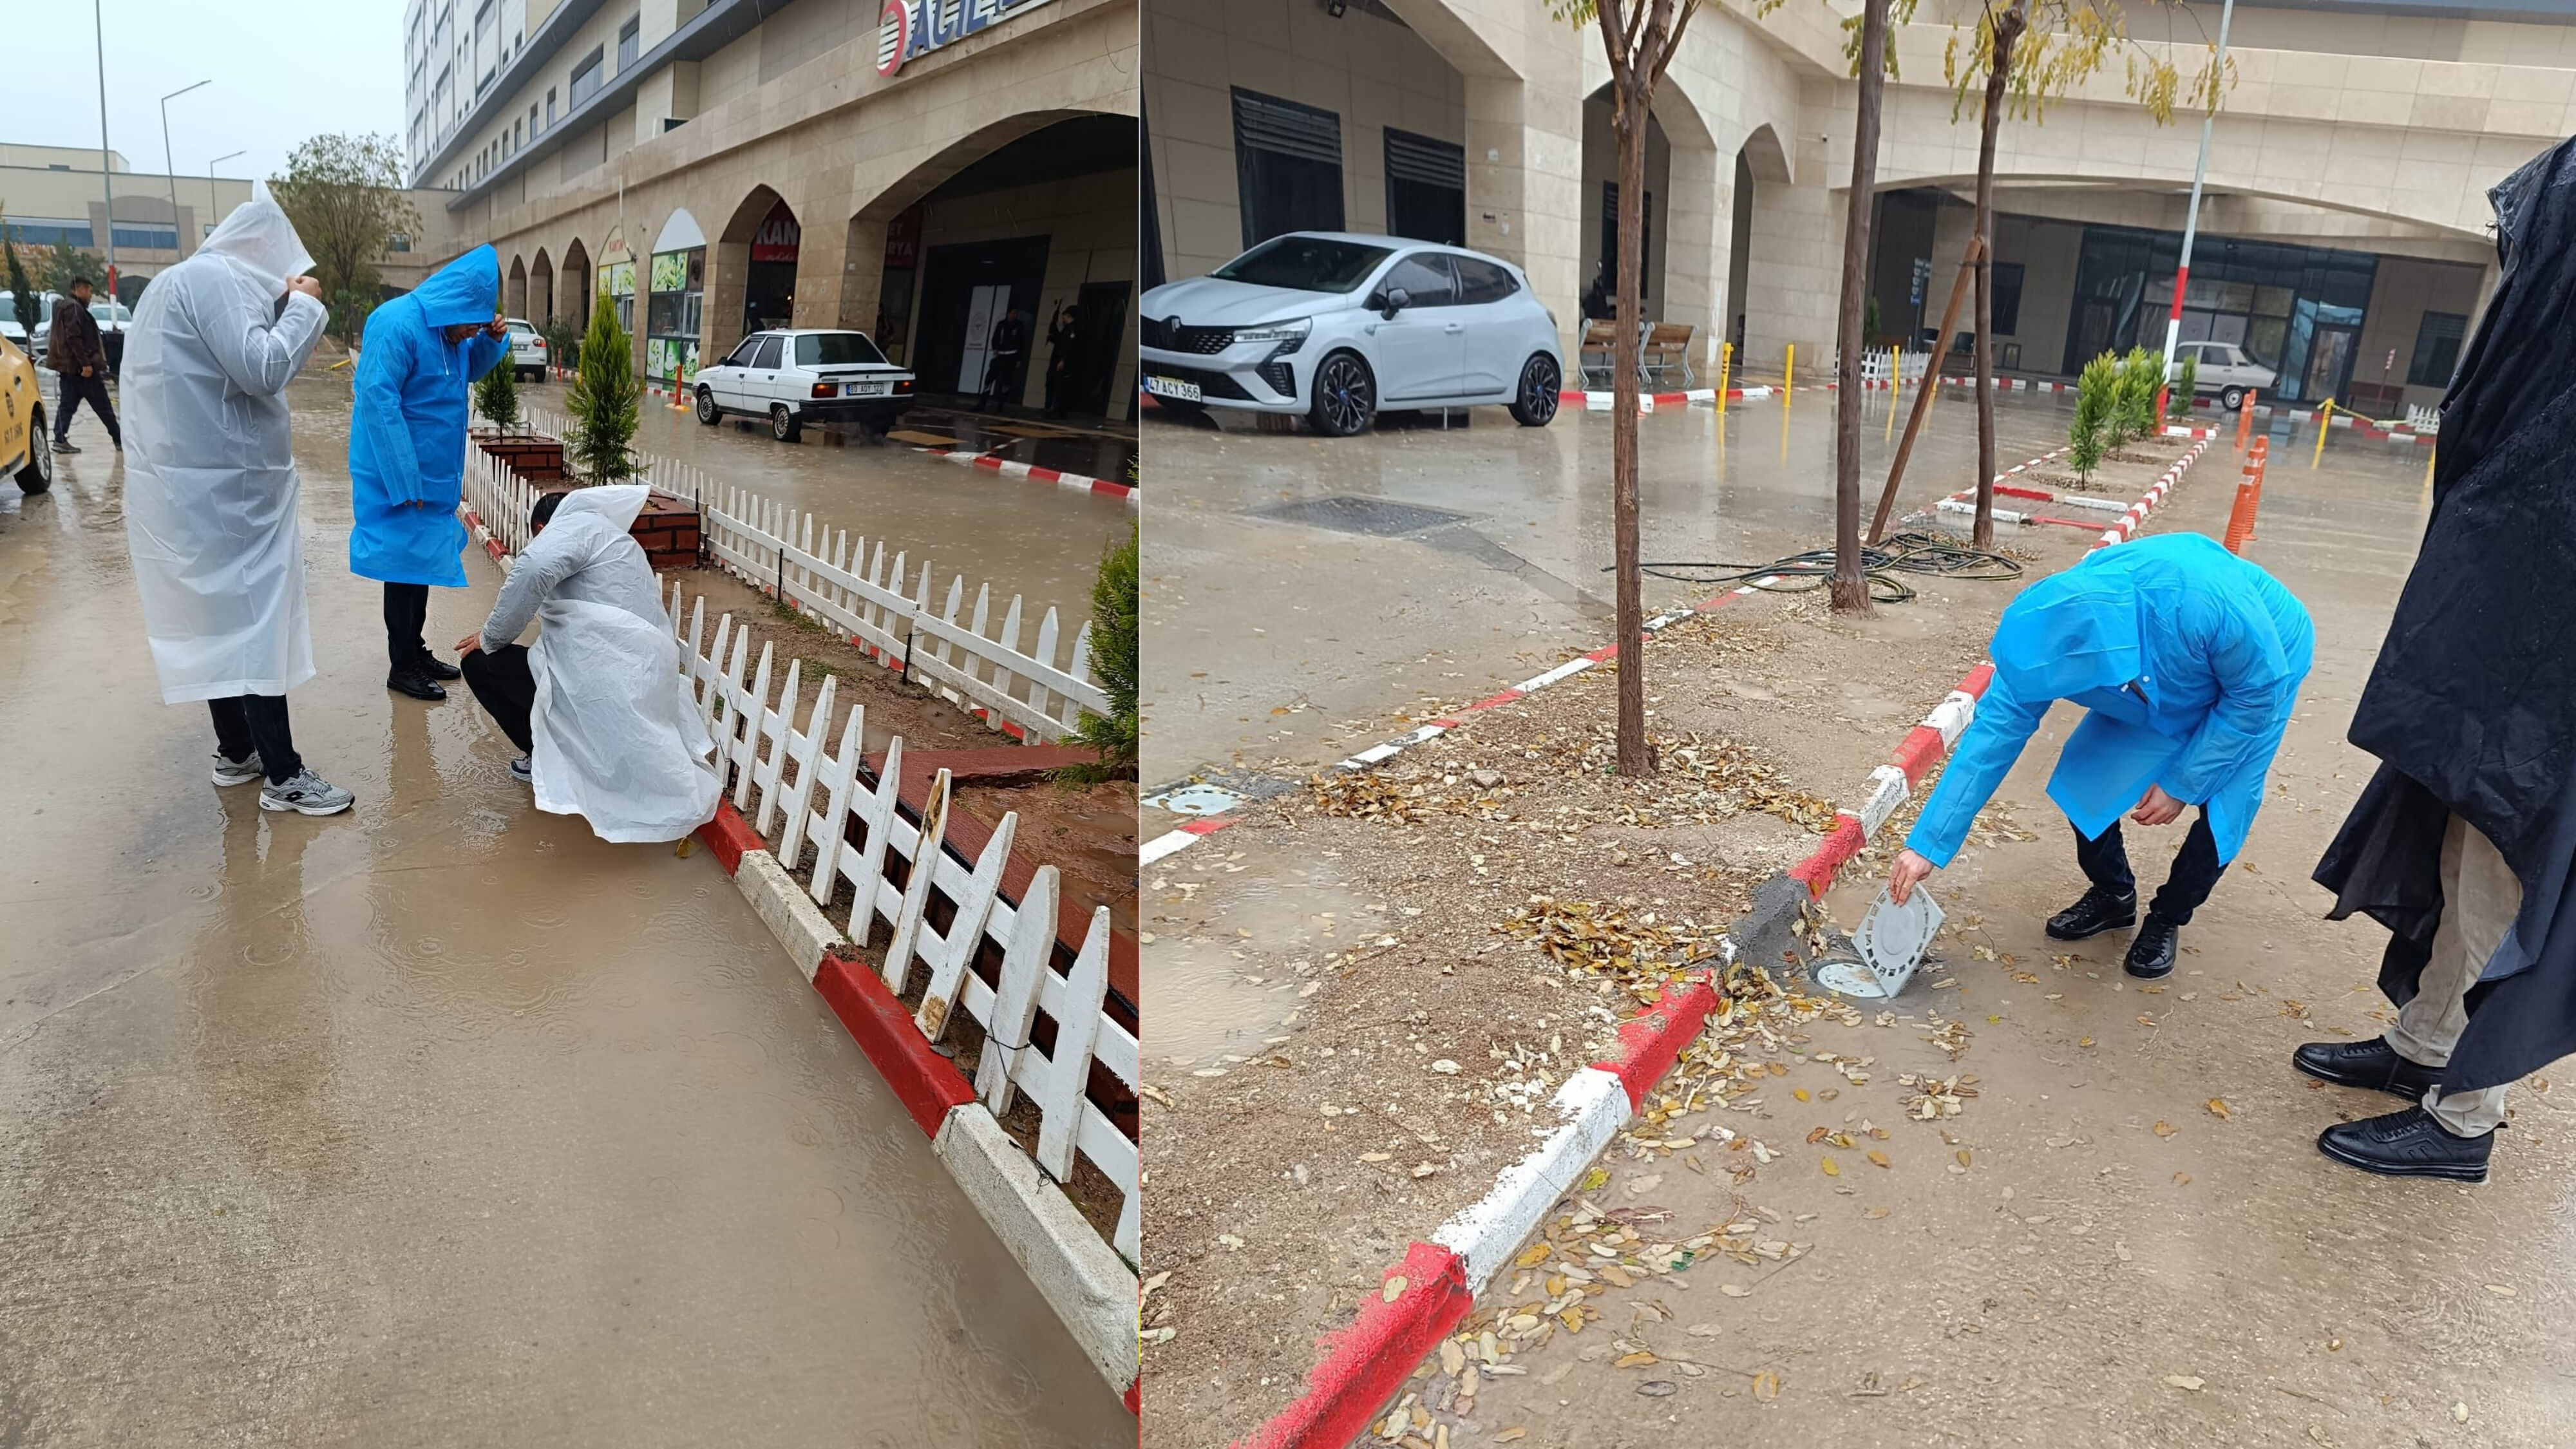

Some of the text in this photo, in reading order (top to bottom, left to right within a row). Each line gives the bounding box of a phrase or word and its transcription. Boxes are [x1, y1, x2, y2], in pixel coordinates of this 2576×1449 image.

[1150, 379, 1199, 399] 47 ACY 366
